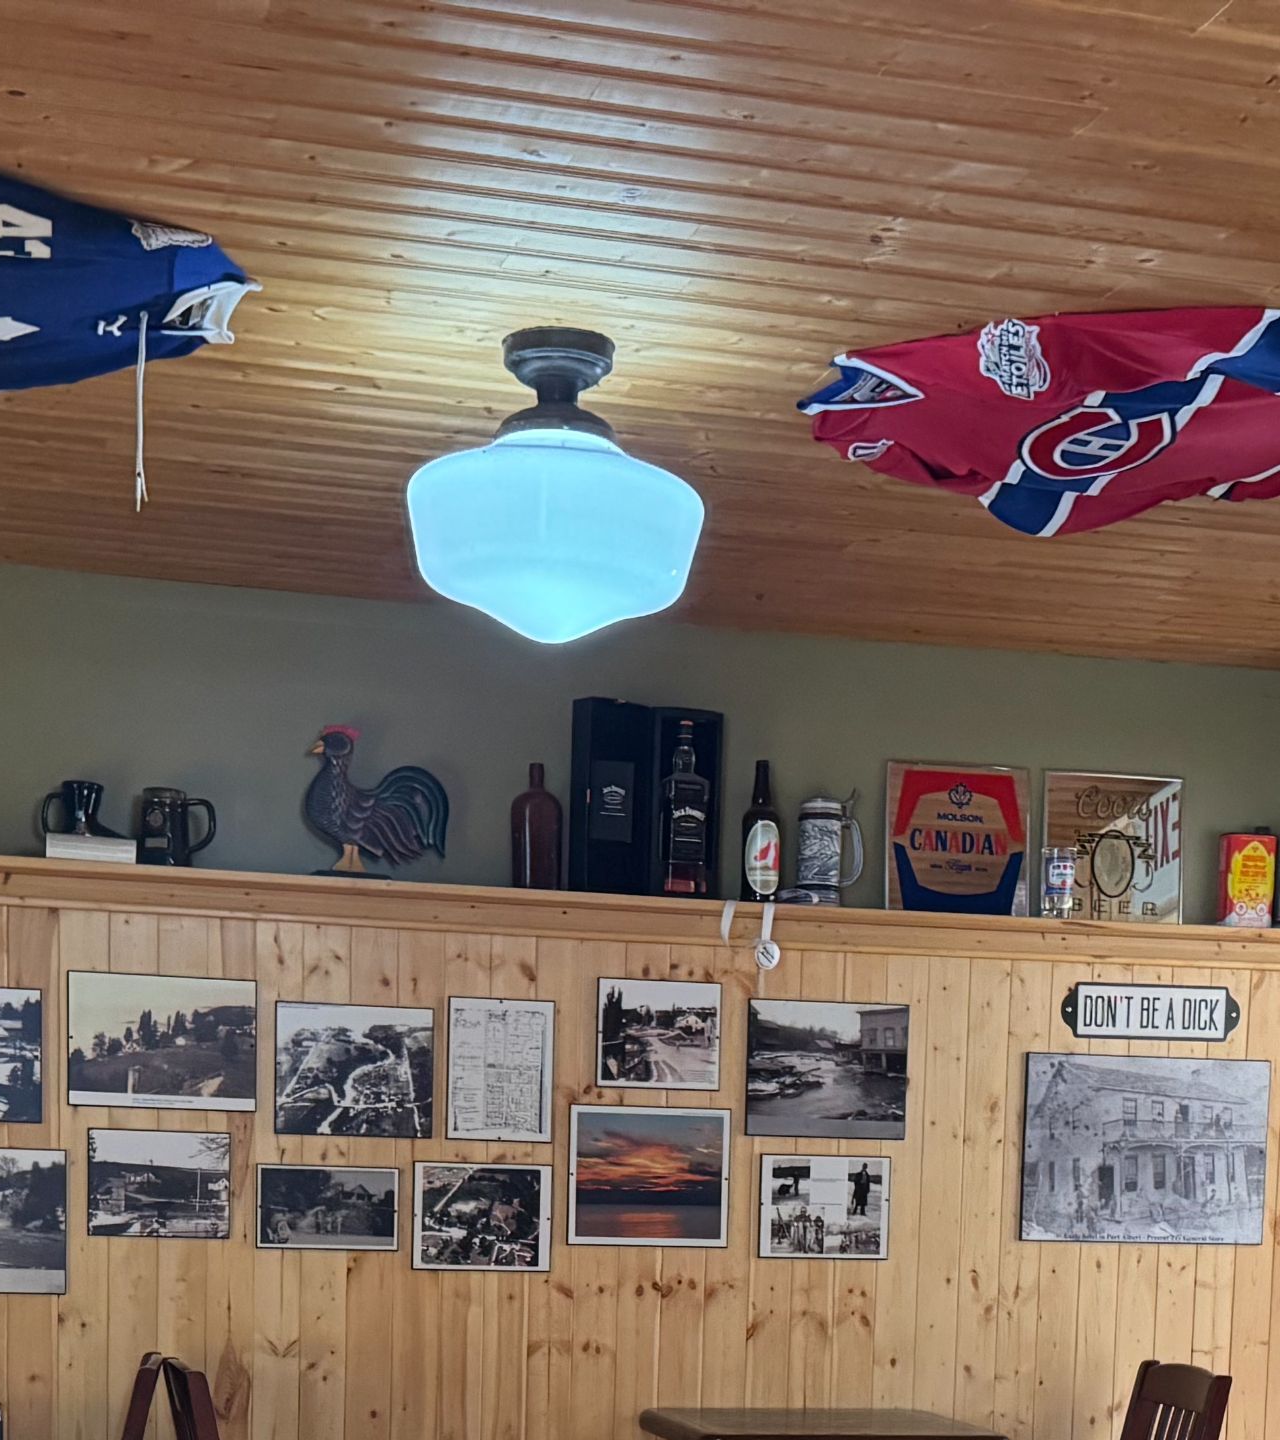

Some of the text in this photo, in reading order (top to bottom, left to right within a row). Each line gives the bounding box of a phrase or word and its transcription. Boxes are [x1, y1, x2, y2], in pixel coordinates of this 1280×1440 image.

[936, 812, 983, 824] MOLSON
[909, 828, 1009, 857] CANADIAN
[1072, 897, 1159, 917] BEER
[1083, 994, 1220, 1032] DON'T BE A DICK
